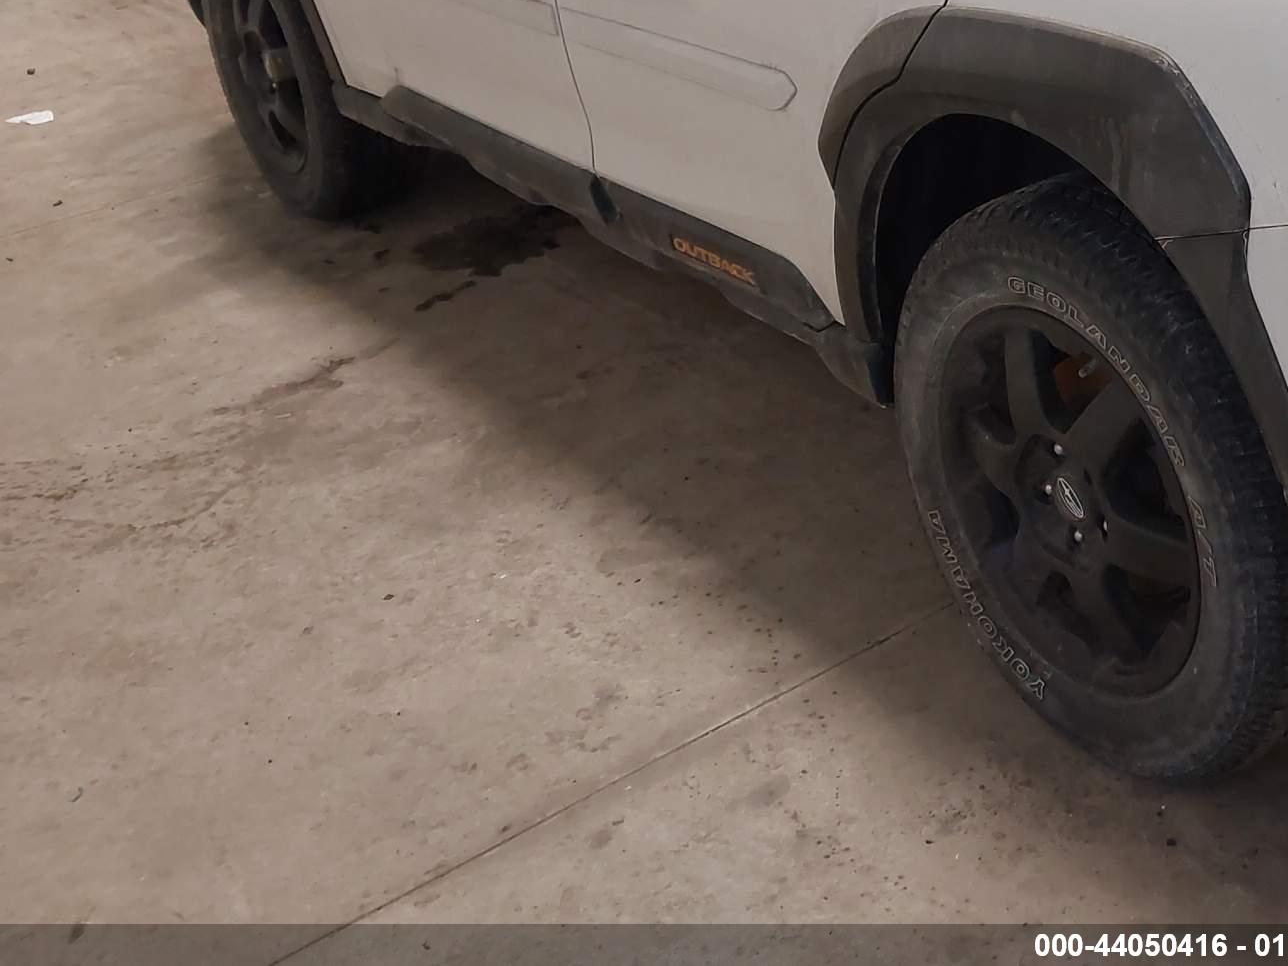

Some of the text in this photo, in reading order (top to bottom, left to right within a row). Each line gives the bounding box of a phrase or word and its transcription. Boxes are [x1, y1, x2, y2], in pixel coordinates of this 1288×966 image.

[672, 237, 757, 286] OUTBACK
[1007, 276, 1186, 468] GEOLANDAR
[927, 509, 1047, 701] YOKOHAMA
